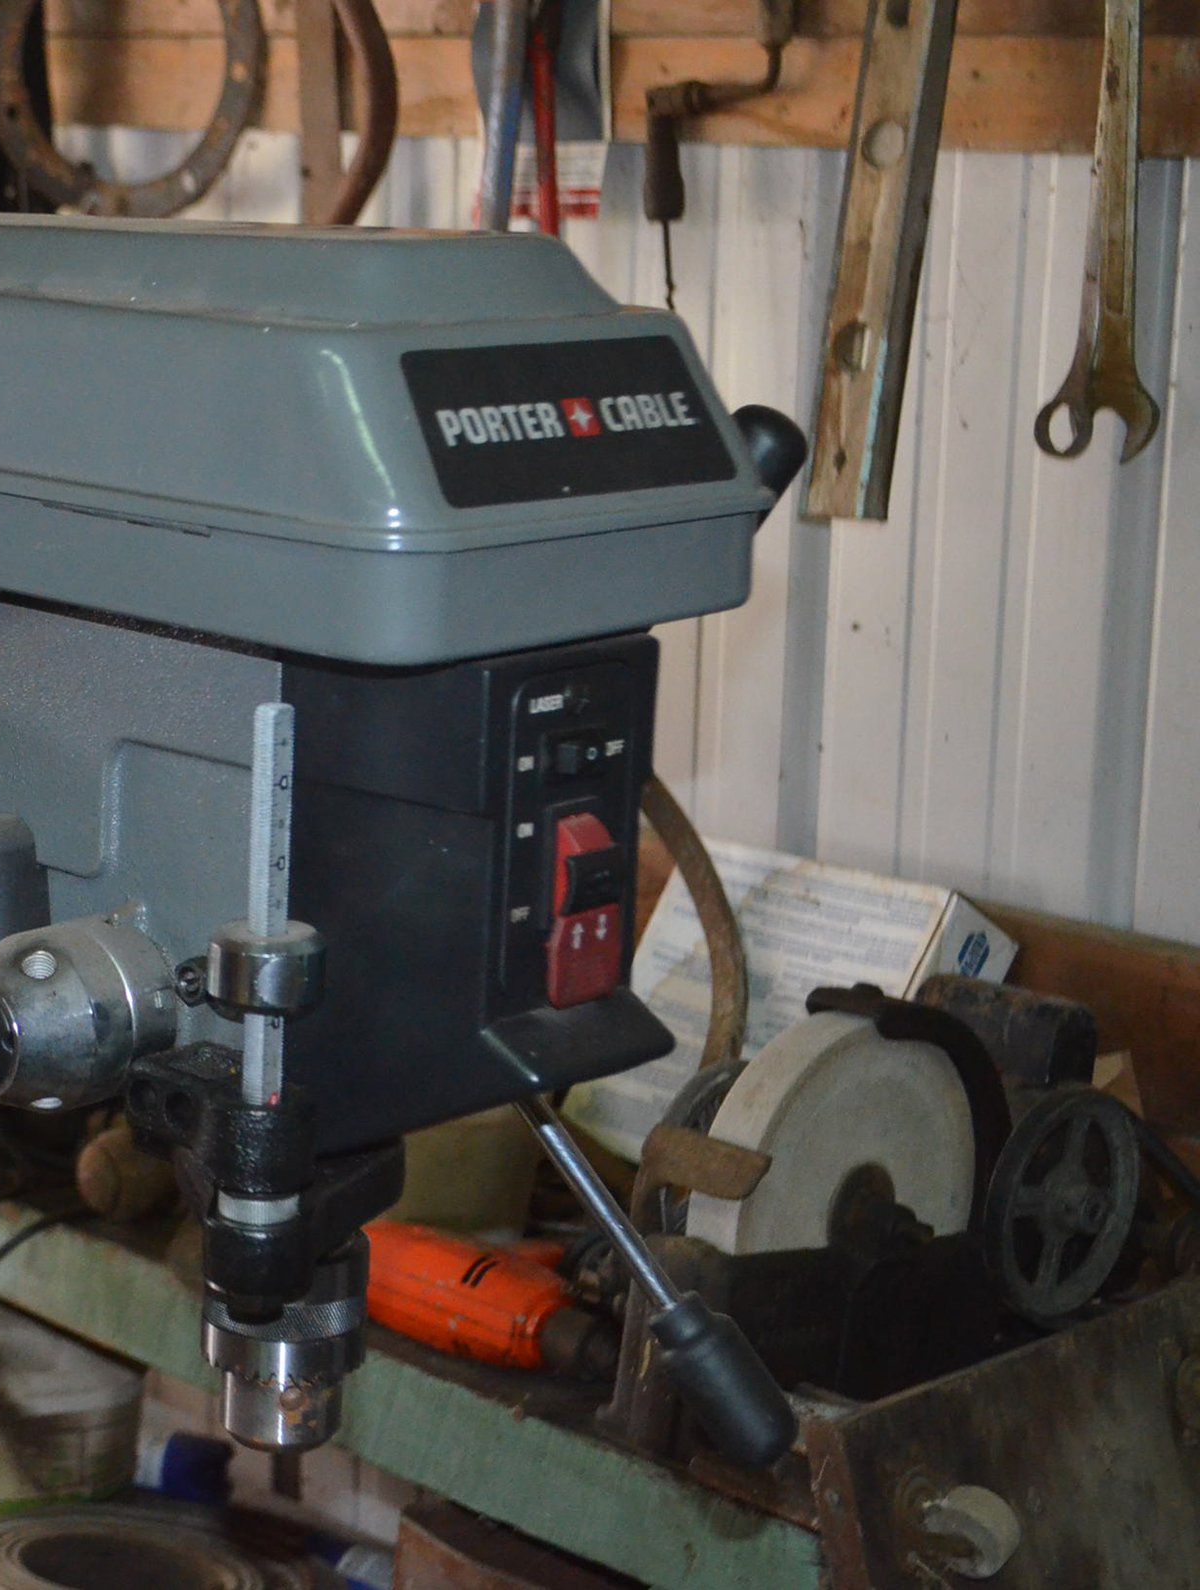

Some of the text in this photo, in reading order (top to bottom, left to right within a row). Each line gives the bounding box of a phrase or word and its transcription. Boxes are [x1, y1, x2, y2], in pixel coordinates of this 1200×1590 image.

[436, 391, 698, 447] PORTER CABLE
[529, 694, 564, 714] LASER
